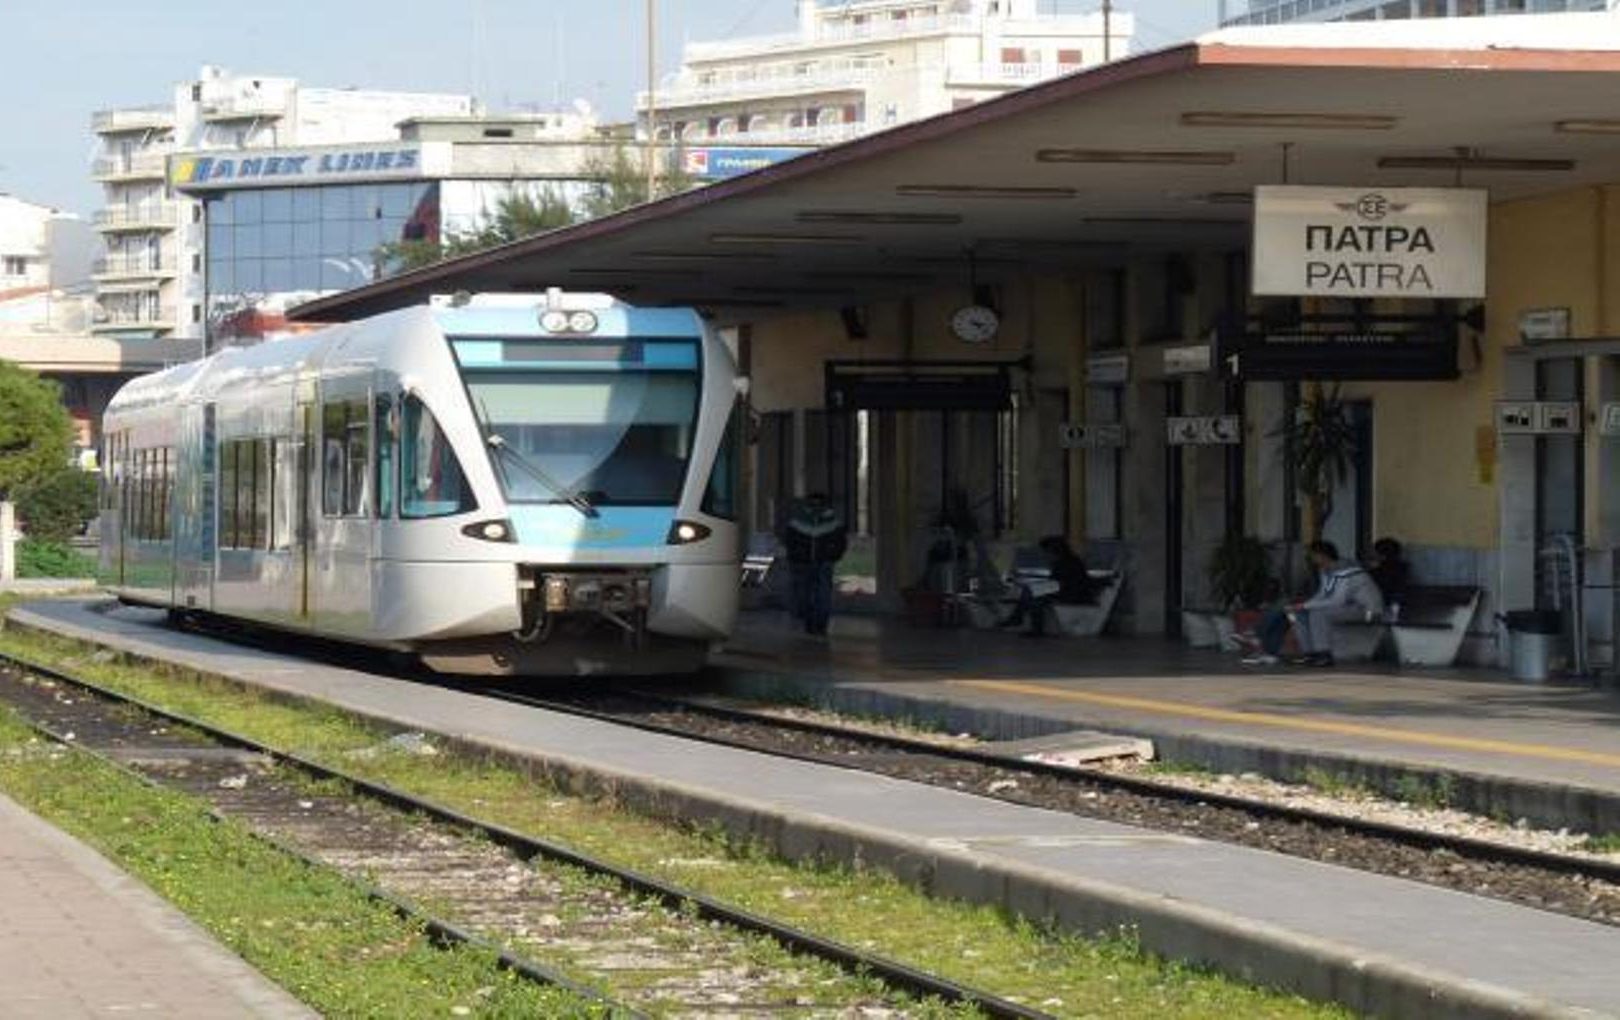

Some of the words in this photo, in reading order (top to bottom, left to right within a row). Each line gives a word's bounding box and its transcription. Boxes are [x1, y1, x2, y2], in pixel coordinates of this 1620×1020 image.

[209, 156, 309, 178] ANEK
[319, 150, 419, 173] LINES
[1306, 225, 1435, 253] ΠΑΤΡΑ
[1306, 261, 1433, 290] PATRA
[1226, 353, 1240, 377] 1
